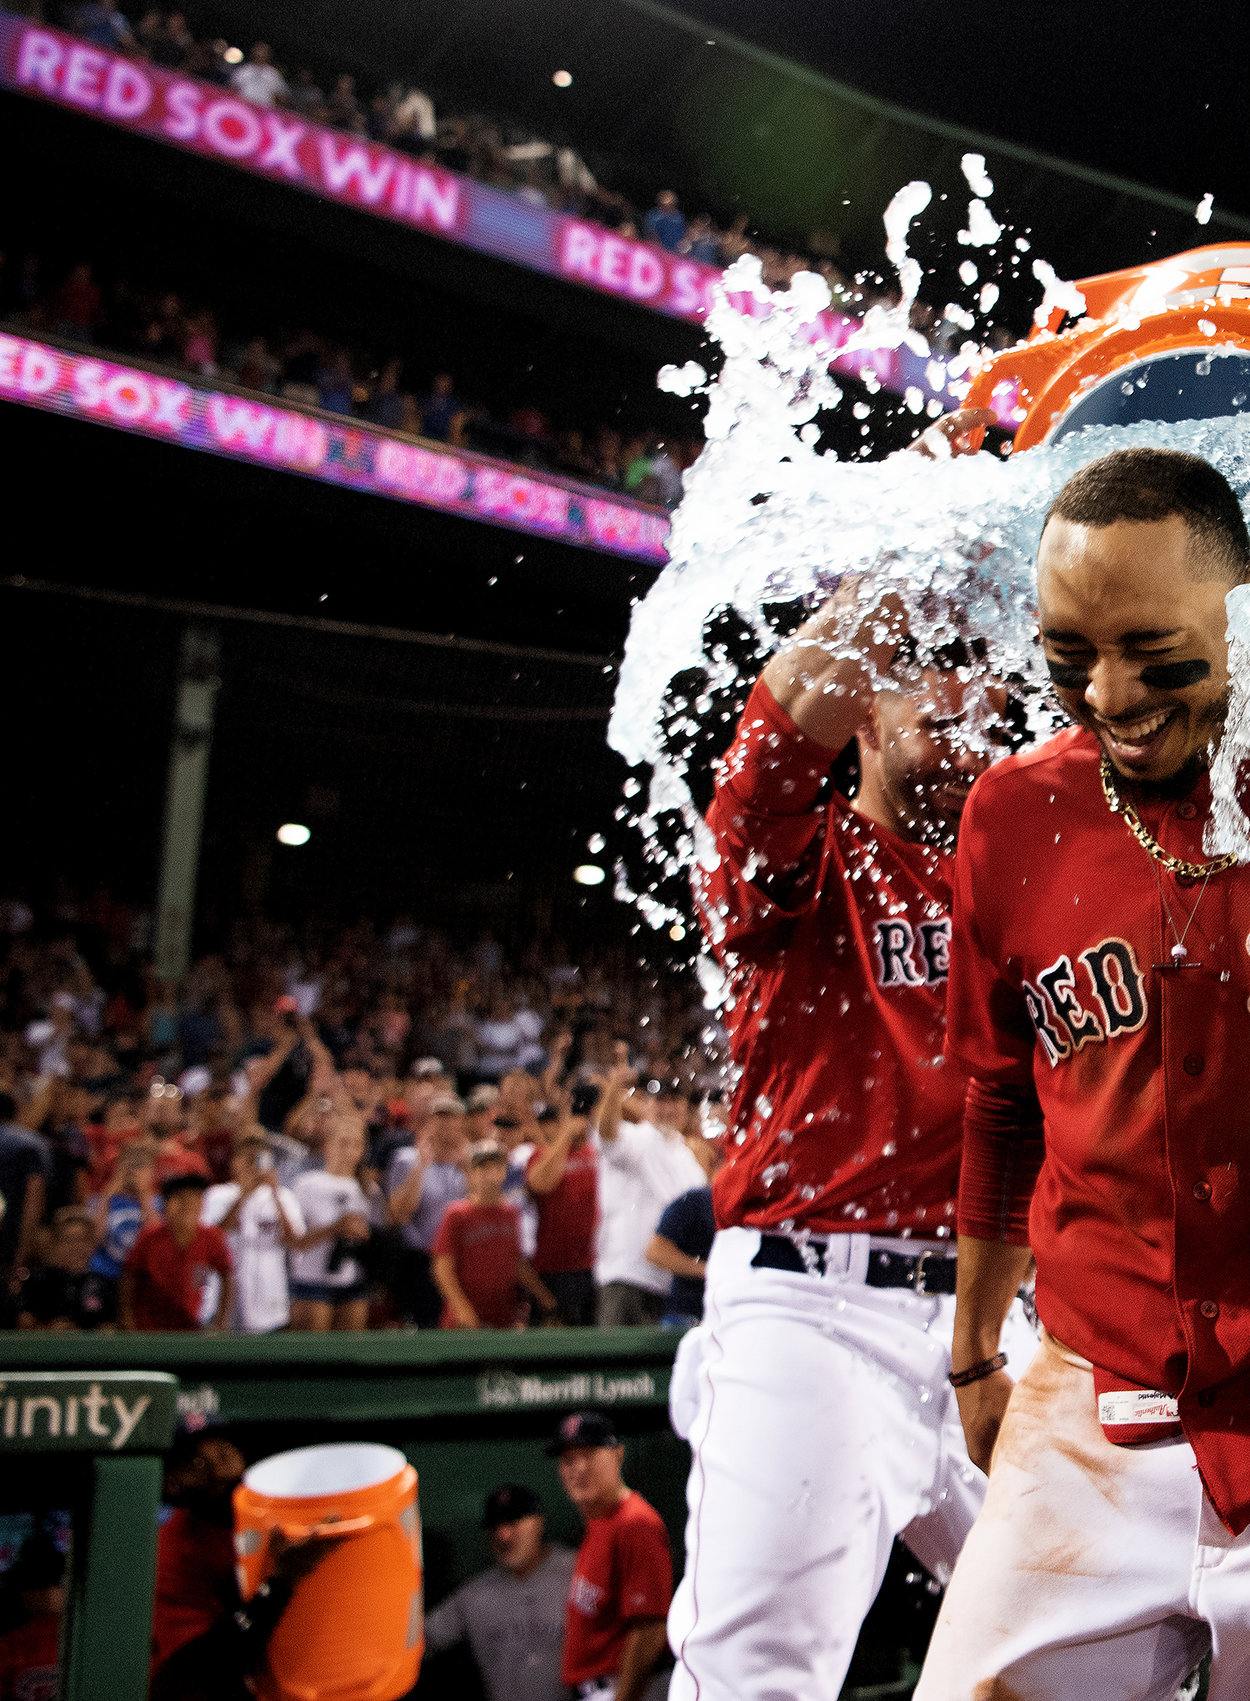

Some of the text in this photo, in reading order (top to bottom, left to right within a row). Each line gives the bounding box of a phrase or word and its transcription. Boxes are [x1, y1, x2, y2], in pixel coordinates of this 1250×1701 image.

[17, 29, 459, 232] RED SOX WIN
[565, 224, 666, 299] RED
[73, 362, 190, 432] SOX
[873, 916, 952, 989] RE
[1022, 936, 1149, 1069] RED
[521, 1373, 656, 1404] Merrill Lynch
